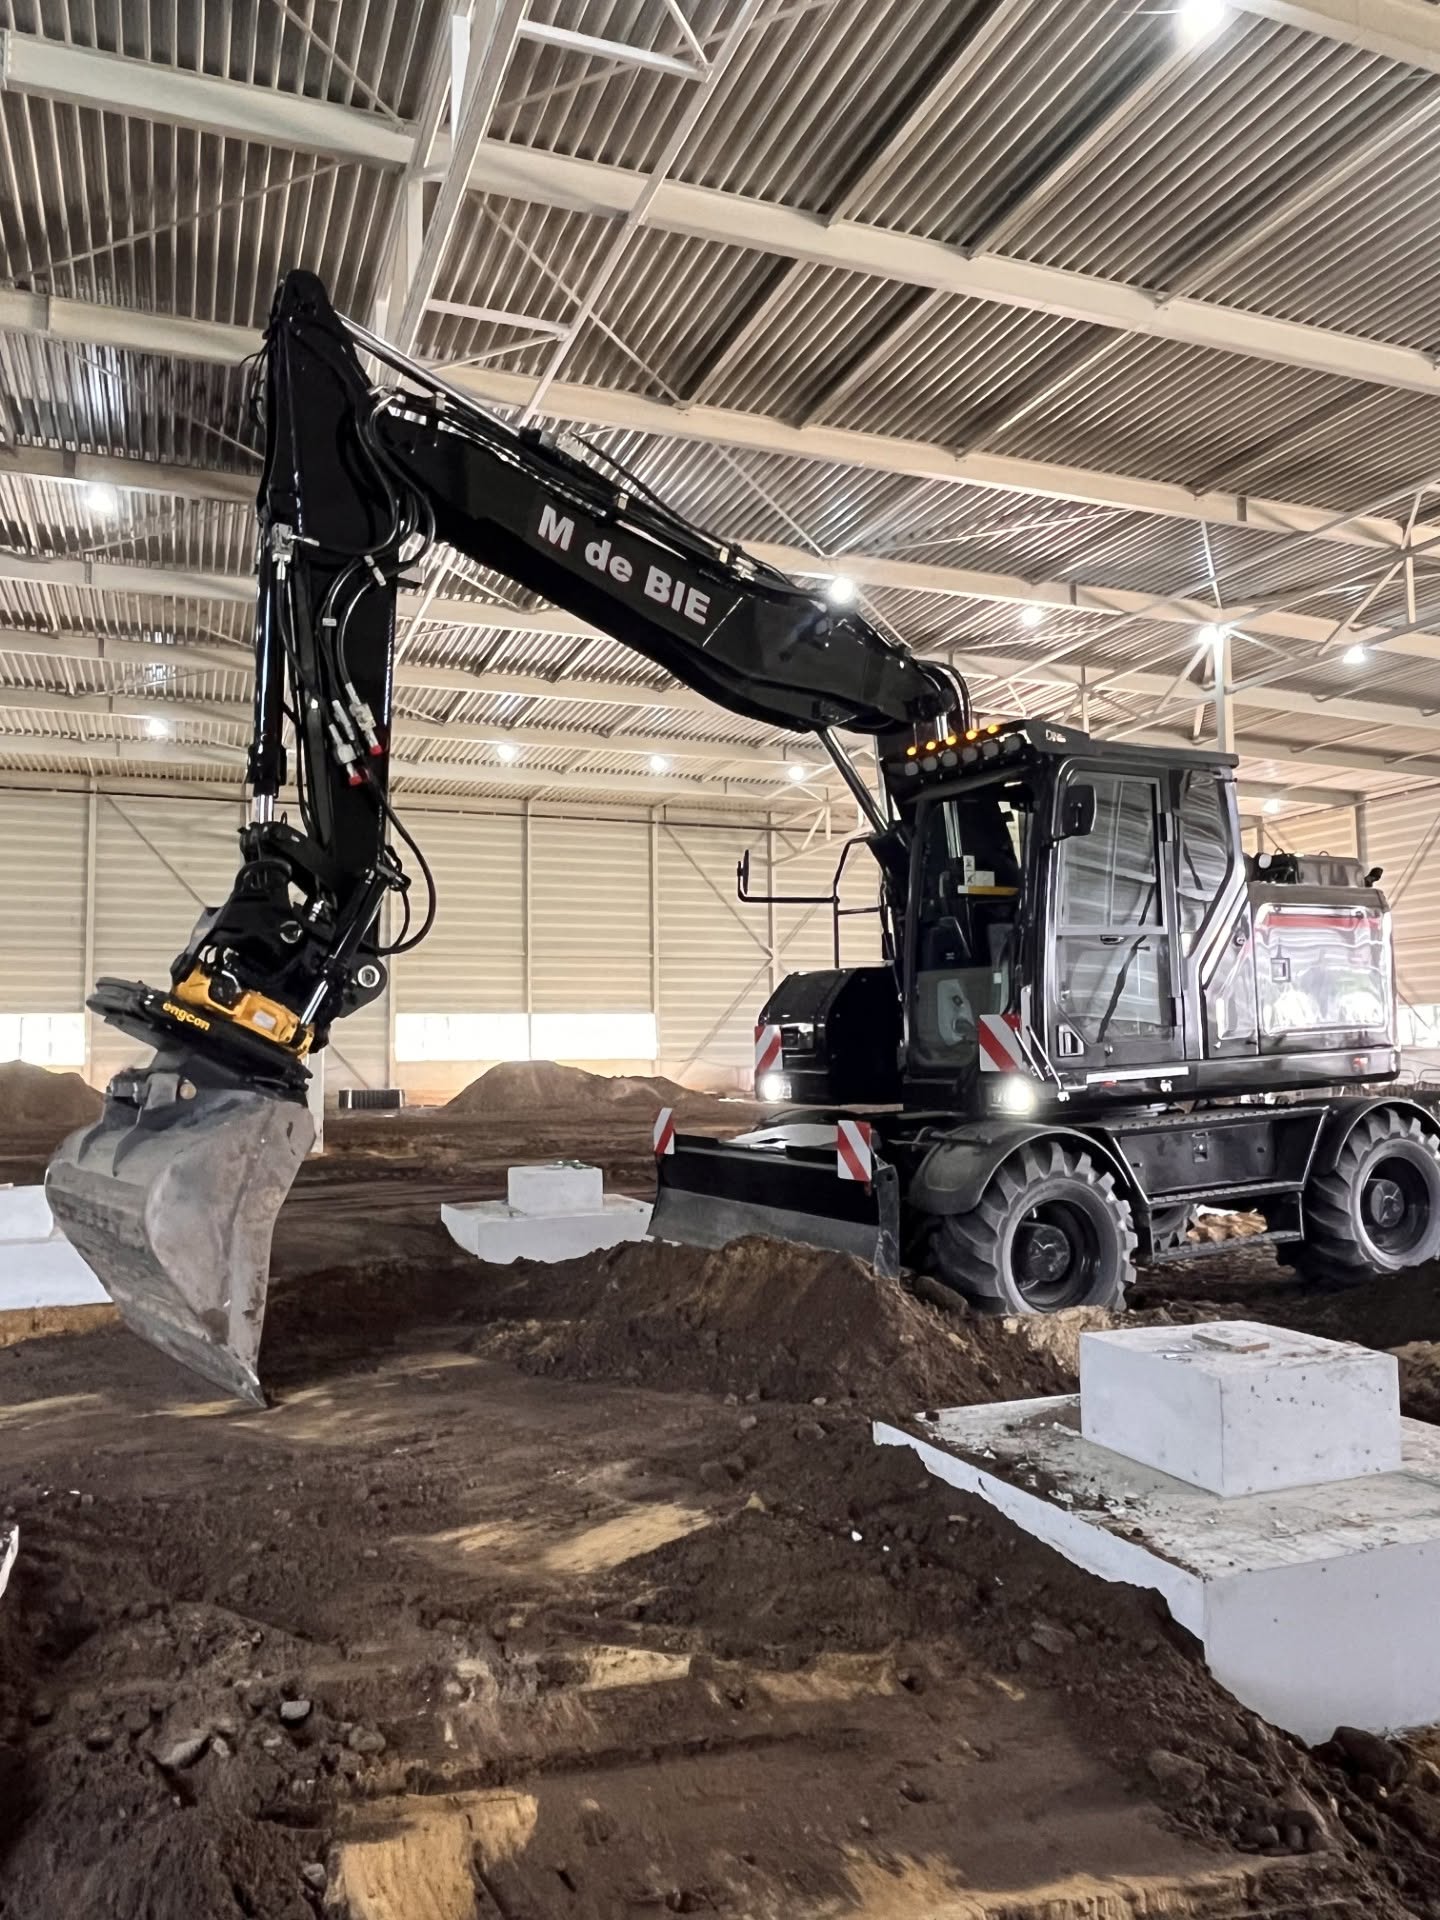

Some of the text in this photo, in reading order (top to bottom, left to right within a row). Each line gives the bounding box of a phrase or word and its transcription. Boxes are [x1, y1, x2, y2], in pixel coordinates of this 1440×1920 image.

[537, 504, 711, 625] M de BIE
[162, 1002, 210, 1031] engcon
